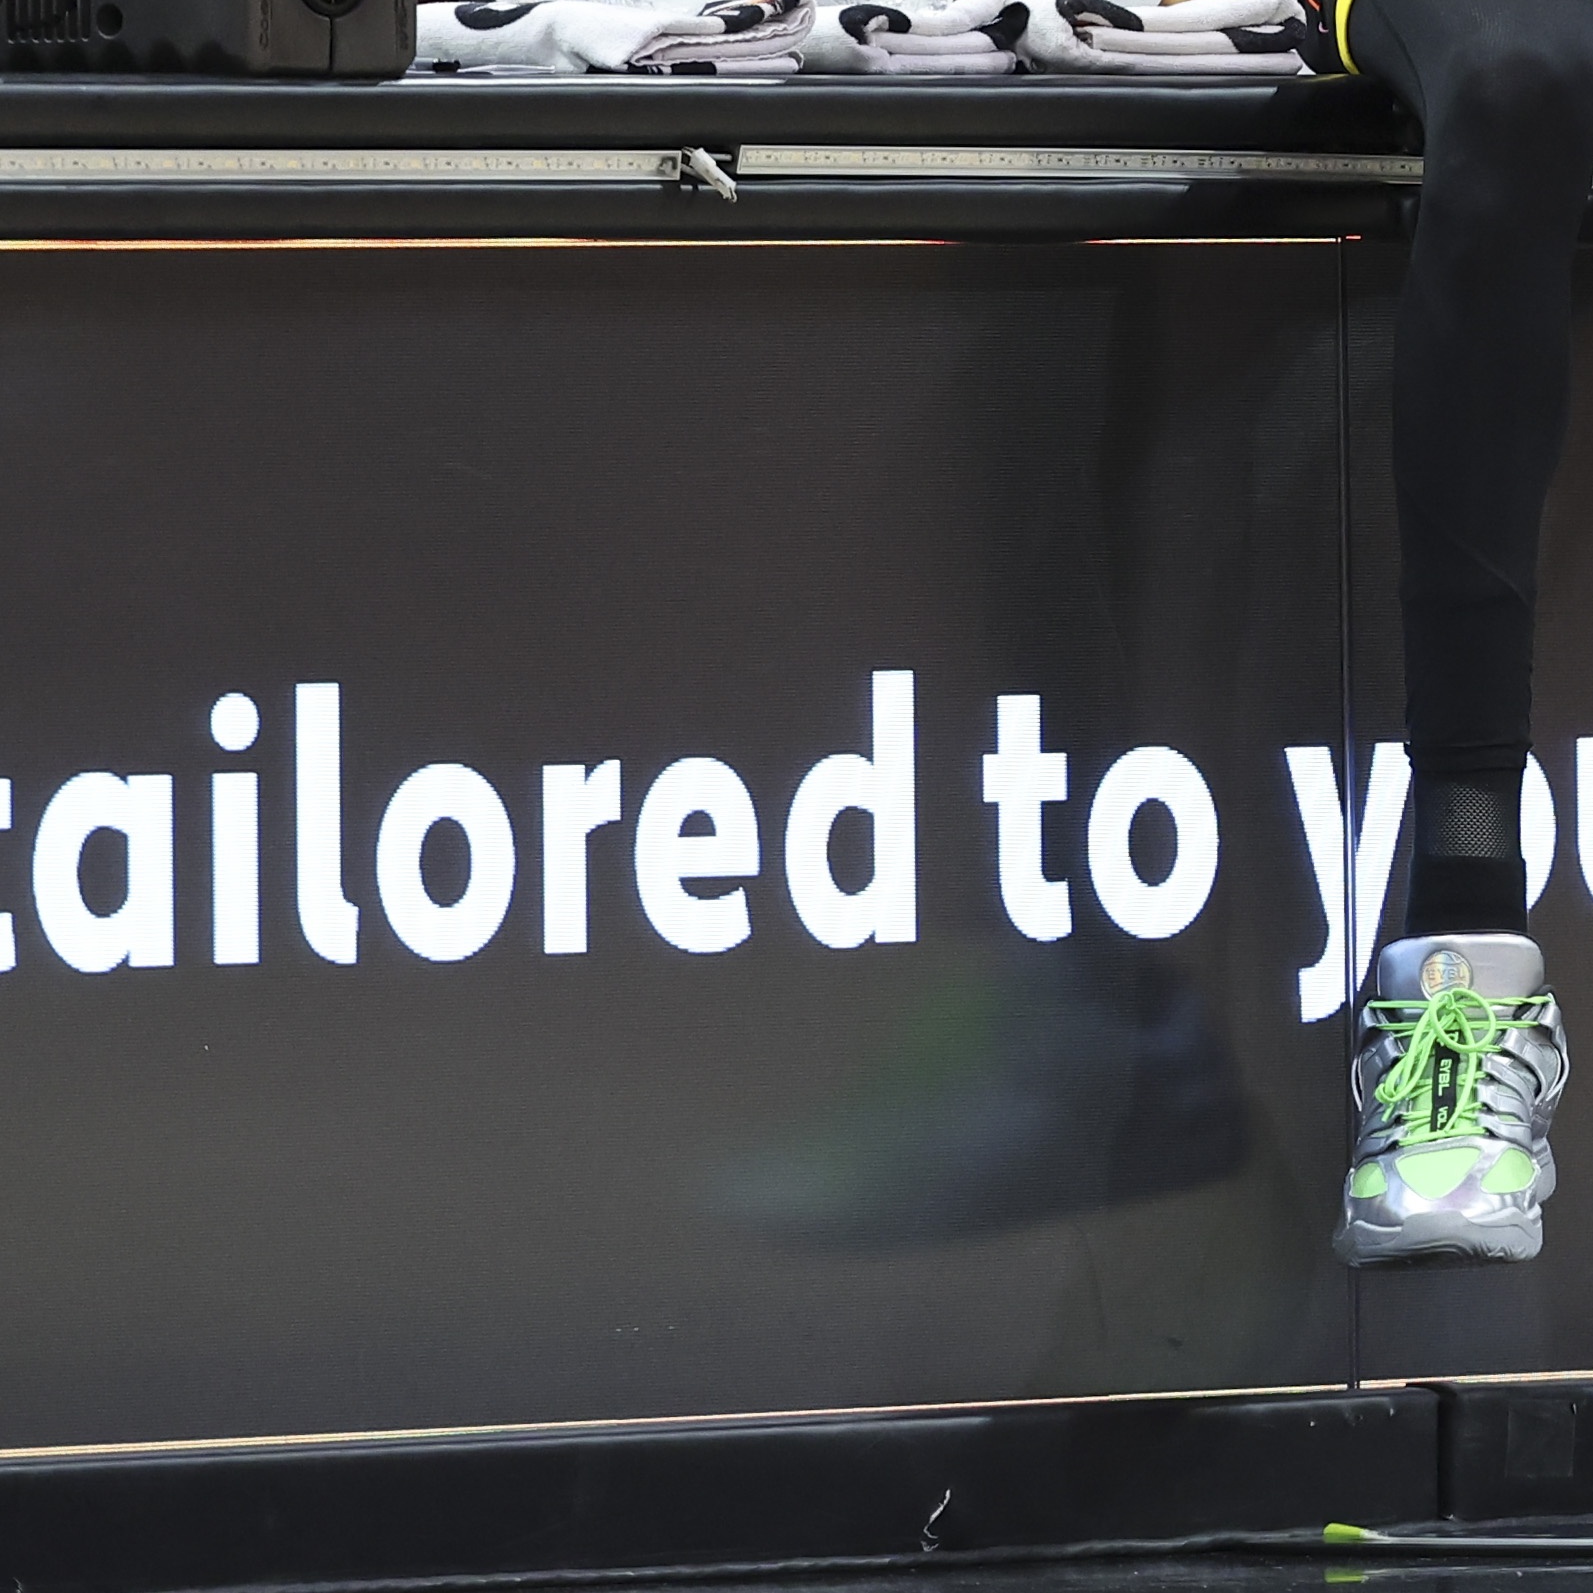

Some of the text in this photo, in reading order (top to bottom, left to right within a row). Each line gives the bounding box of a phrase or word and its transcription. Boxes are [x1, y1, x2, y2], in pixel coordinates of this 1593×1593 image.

[0, 668, 919, 974] ailored
[981, 693, 1220, 943] to
[1427, 967, 1466, 984] EYBL
[1437, 1058, 1450, 1097] EYBL
